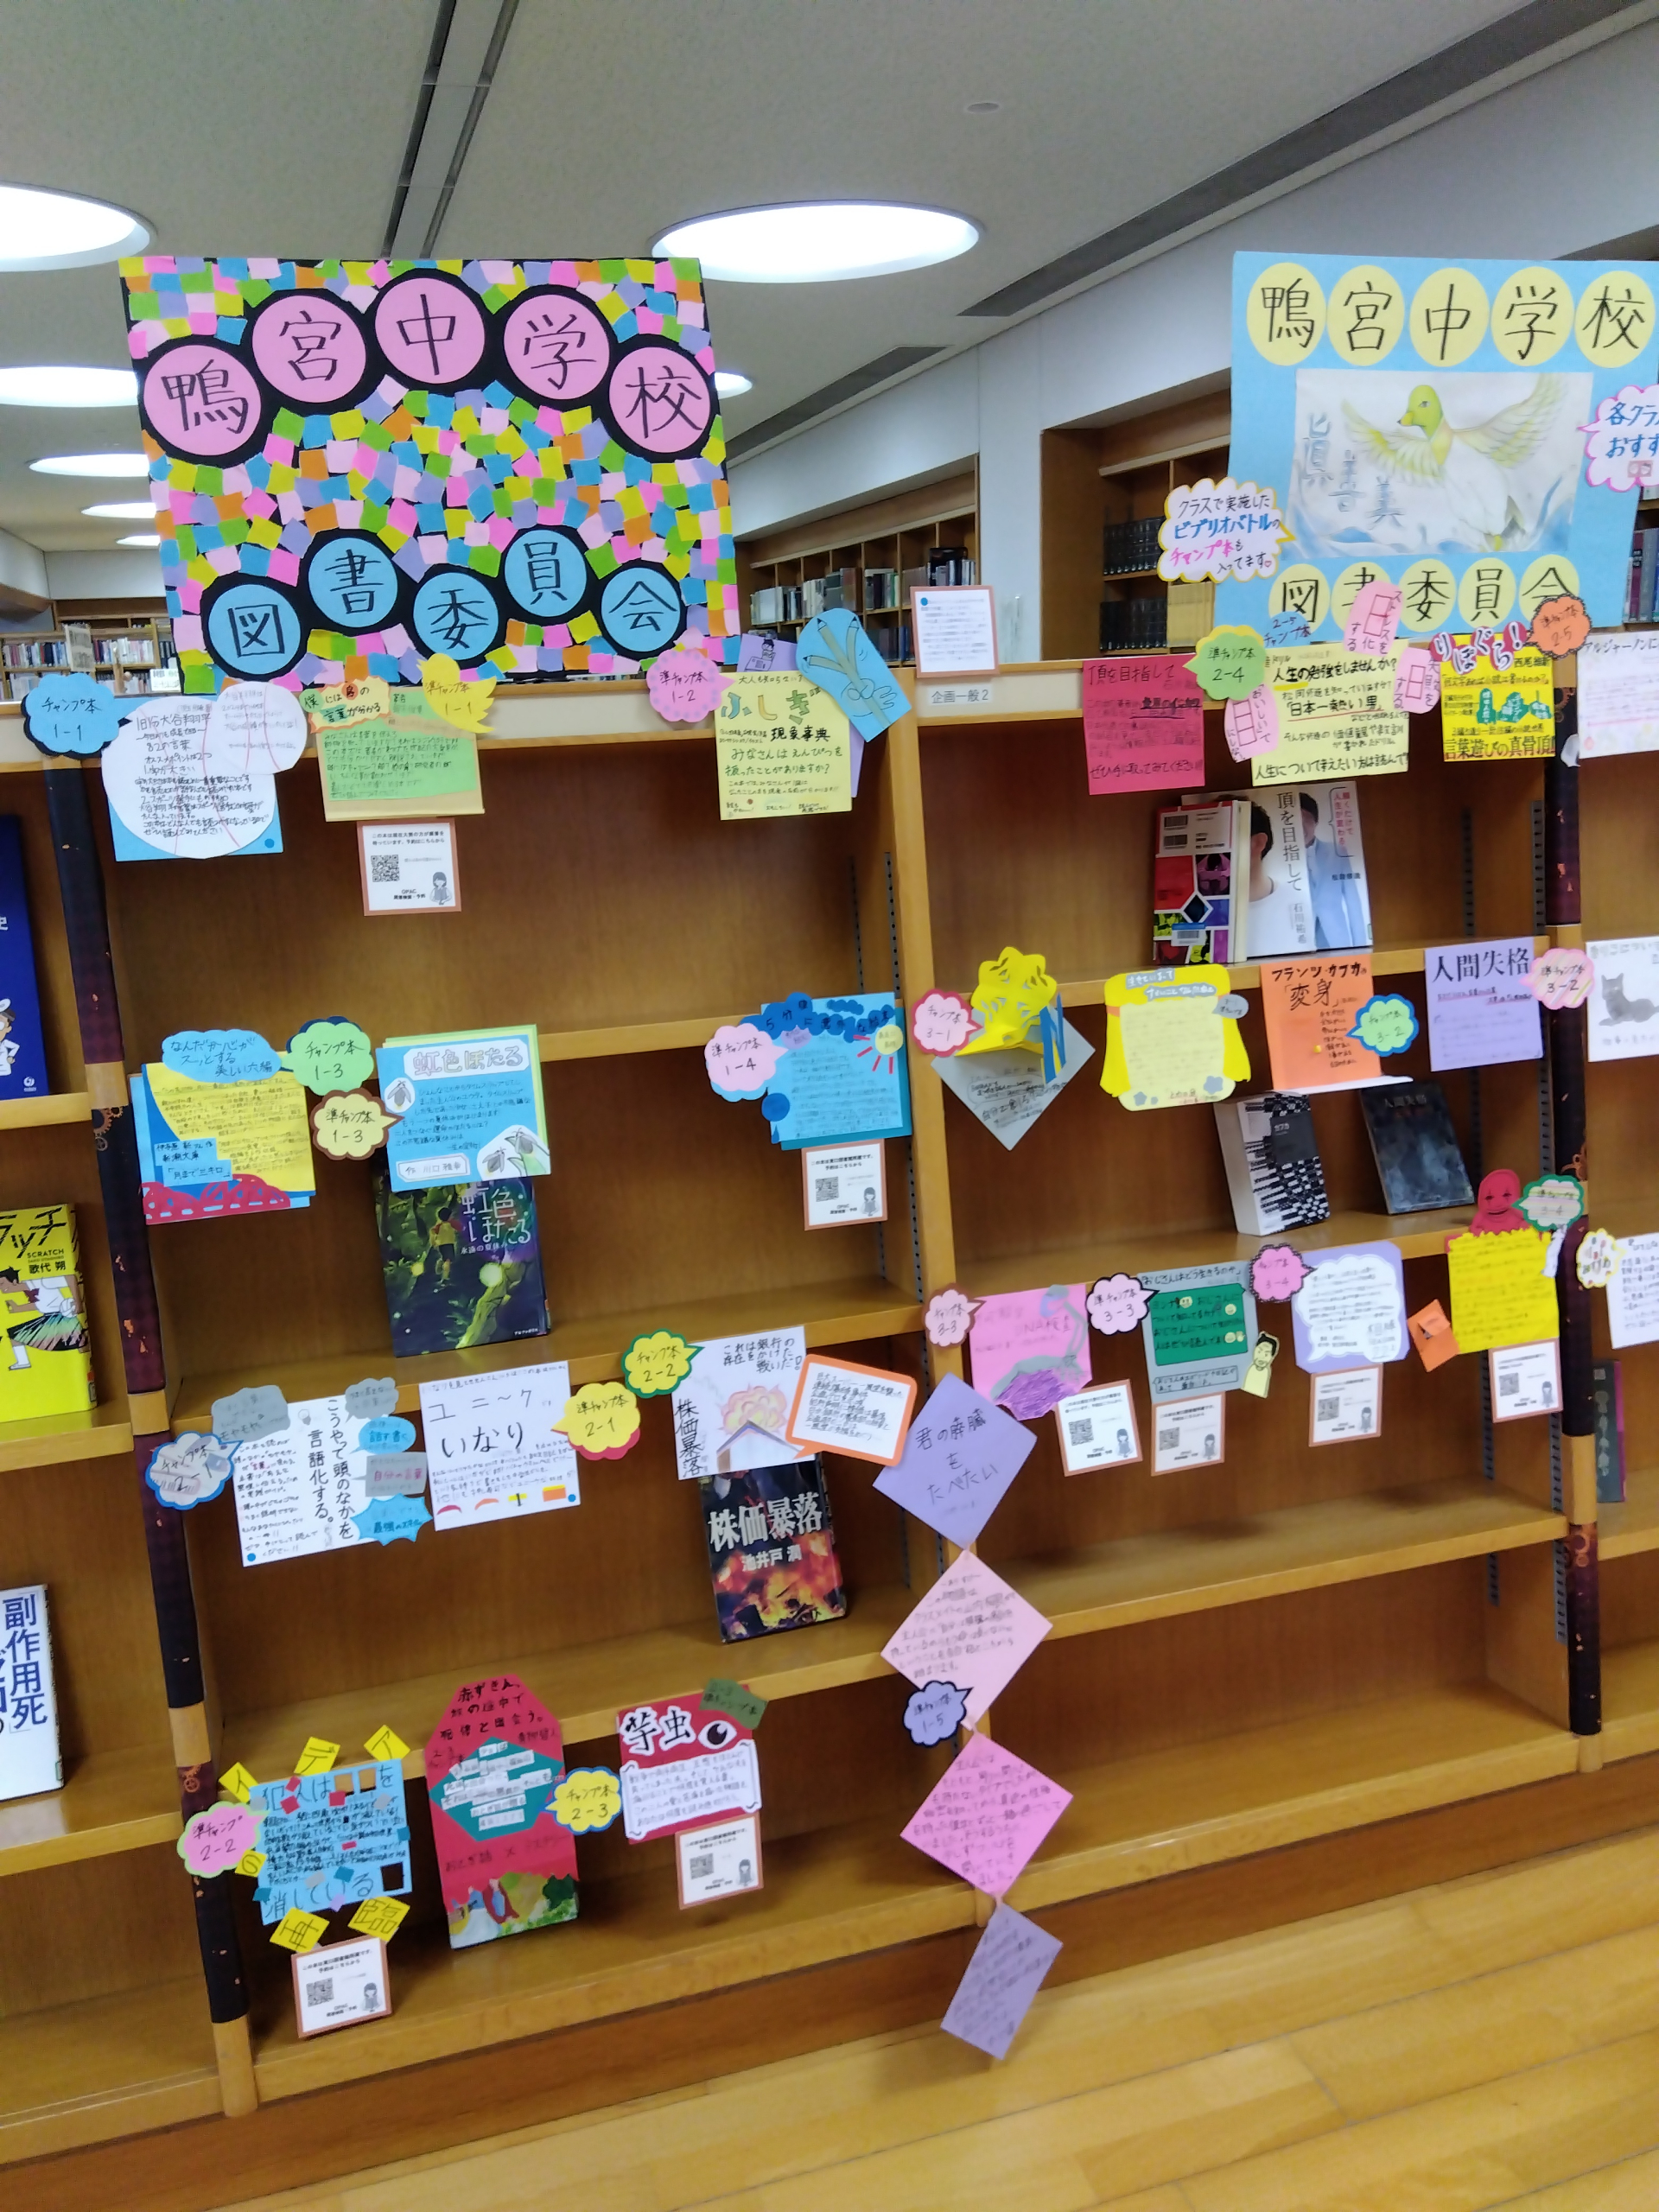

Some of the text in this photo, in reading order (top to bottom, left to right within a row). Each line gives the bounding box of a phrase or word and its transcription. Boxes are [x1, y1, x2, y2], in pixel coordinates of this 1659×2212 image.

[1261, 277, 1647, 361] 鴨宮中学校
[161, 293, 703, 439] 鴨宮中学校
[1605, 402, 1659, 427] 各クラ
[1605, 434, 1659, 459] おすす
[1178, 495, 1271, 519] クラスで実施した
[1174, 513, 1281, 540] ビブリオバトルの
[1170, 539, 1244, 567] チャンプ本も
[227, 539, 678, 658] 図書委員会
[1346, 621, 1362, 652] する
[1207, 647, 1257, 661] 準チャンプ本
[659, 668, 709, 686] 準チャンプ本
[1089, 664, 1175, 686] 頂を目指して
[1211, 666, 1245, 683] 2-4
[1272, 657, 1398, 683] 人生の勉強をしませんか?
[42, 696, 104, 715] チャンプ本
[671, 691, 696, 703] 1-2
[931, 689, 990, 704] 企画一般2
[444, 701, 474, 715] 1-1
[53, 723, 83, 741] 1-1
[769, 725, 831, 743] 現象事典
[1276, 791, 1303, 892] 頂を目指して
[1432, 947, 1530, 983] 人間失格
[1547, 978, 1580, 993] 3-2
[305, 1039, 365, 1060] チャンプ本
[710, 1037, 764, 1058] 準チャンプ本
[315, 1062, 345, 1080] 1-3
[412, 1044, 524, 1077] 虹色ほたる
[725, 1057, 757, 1077] 1-4
[325, 1109, 377, 1124] 準チャンプ本
[332, 1129, 364, 1143] 1-3
[27, 1248, 65, 1259] SCRATCH
[29, 1260, 67, 1274] 歌代 朔
[1093, 1287, 1138, 1306] 準チャンプ本
[1104, 1303, 1135, 1322] 3-3
[636, 1344, 683, 1364] チャンプ本
[721, 1346, 794, 1367] 存在をかけた
[723, 1338, 795, 1354] これは銀行の
[643, 1363, 676, 1382] 2-2
[575, 1394, 629, 1414] 準チャンプ本
[585, 1417, 615, 1438] 2-1
[674, 1398, 704, 1478] 株価暴落
[915, 1407, 988, 1452] 君の膵臓
[441, 1421, 524, 1459] いなり
[327, 1398, 354, 1540] こうやって頭のなかを
[945, 1452, 963, 1471] を
[308, 1428, 334, 1523] 言語化する。
[373, 1467, 423, 1482] 自分の言葉
[926, 1463, 1000, 1507] たべたい
[707, 1491, 823, 1553] 株価暴落
[741, 1543, 803, 1573] 池井戸 潤
[3, 1593, 48, 1731] 副作用死
[625, 1708, 692, 1752] 芋虫
[379, 1764, 394, 1789] を
[566, 1788, 615, 1802] チャンプ本
[571, 1802, 609, 1821] 2-3
[192, 1815, 244, 1840] 準チャンプ
[200, 1839, 237, 1862] 2-2
